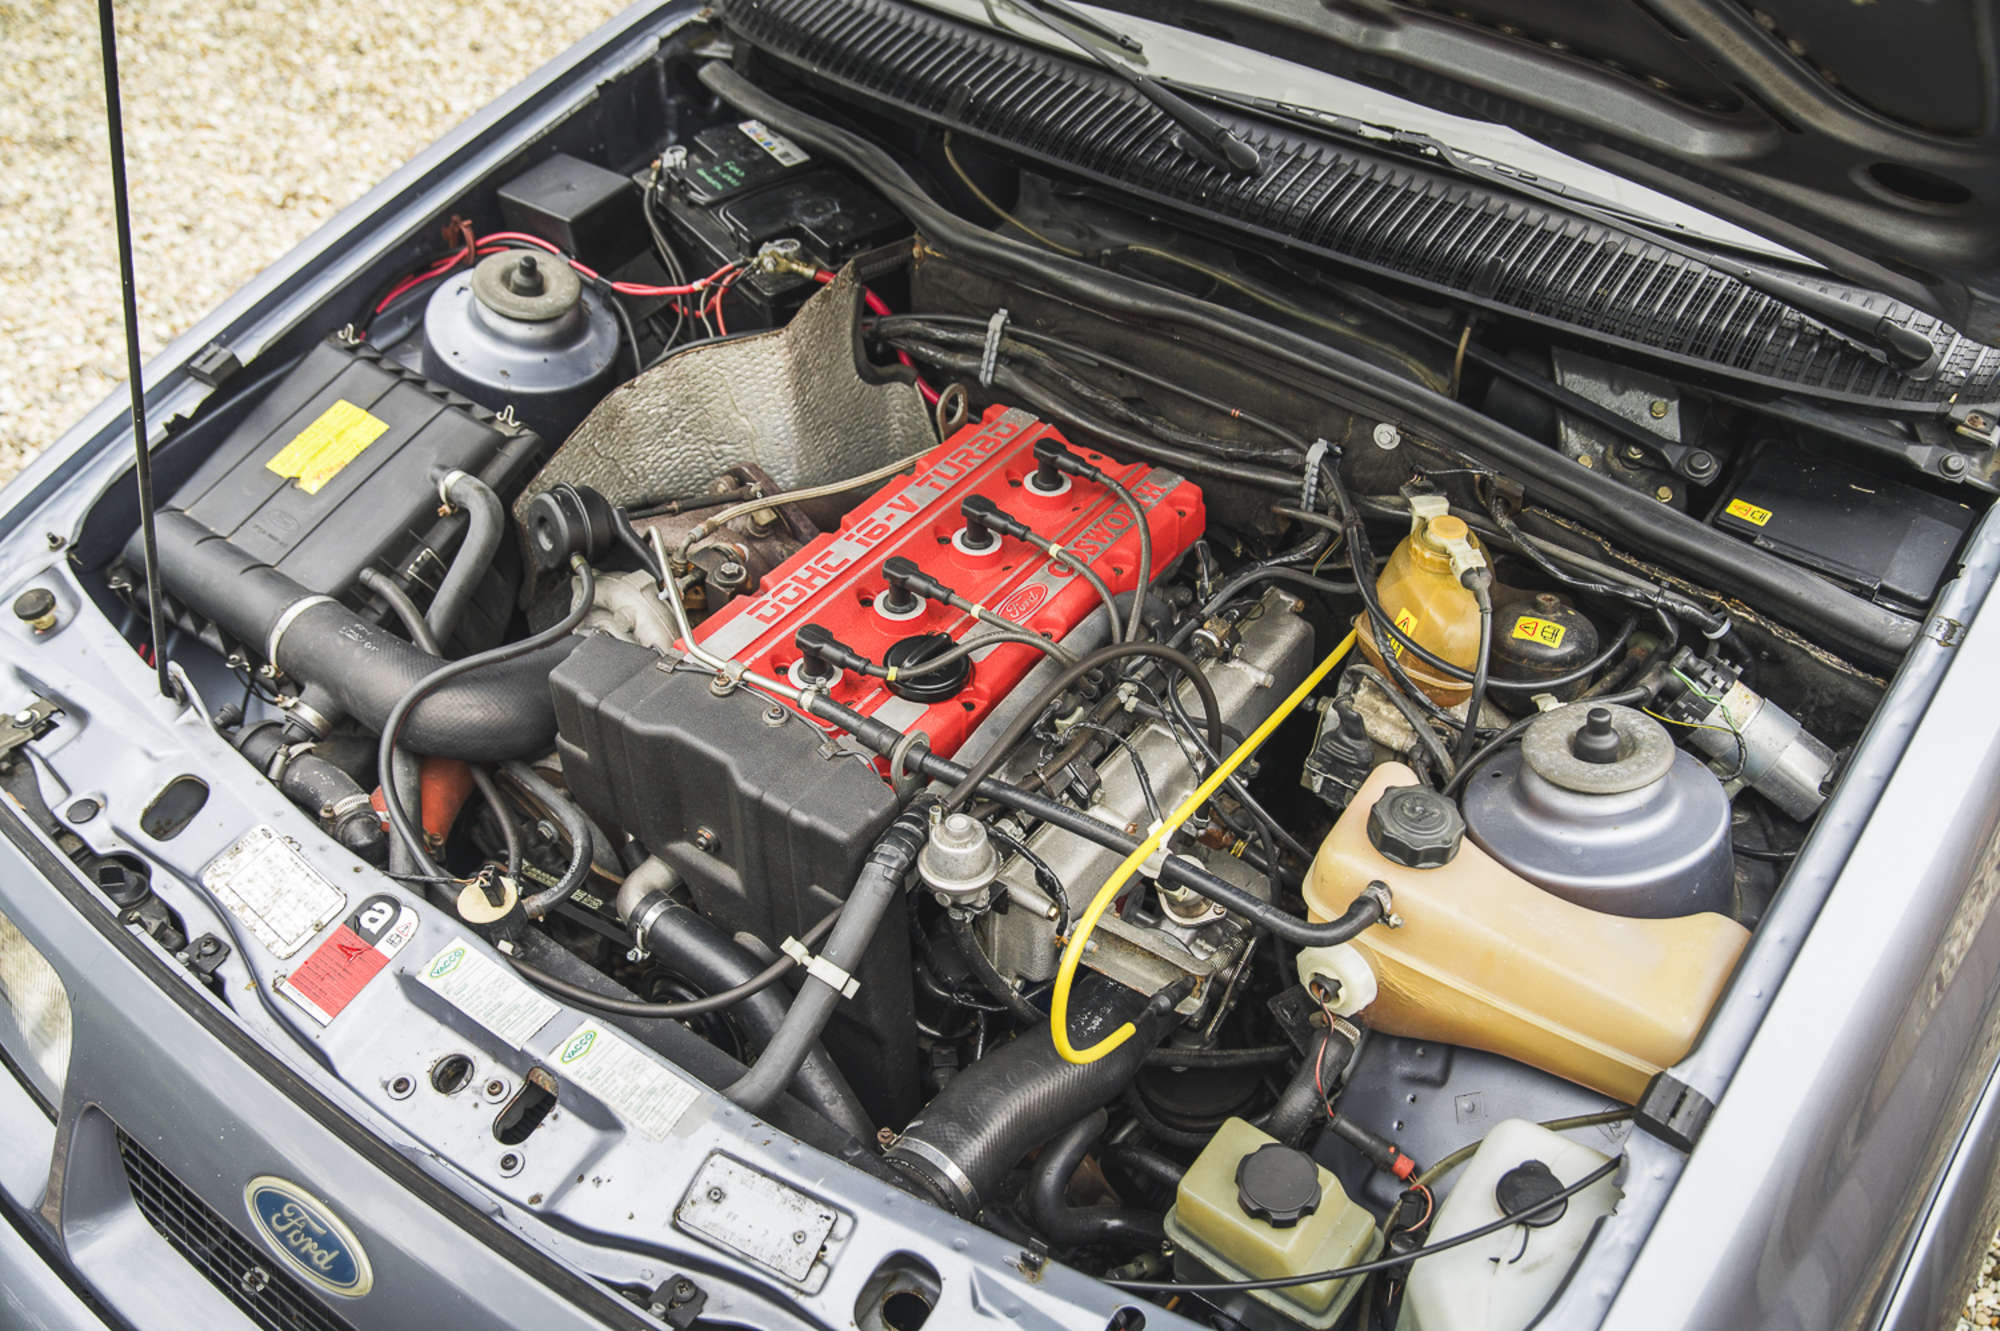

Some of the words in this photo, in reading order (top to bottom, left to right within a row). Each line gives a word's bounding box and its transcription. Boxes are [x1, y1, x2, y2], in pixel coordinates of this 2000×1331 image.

[747, 550, 852, 625] DOHC
[915, 420, 1020, 492] TURBO
[1006, 590, 1039, 618] Ford
[270, 1202, 339, 1271] Ford
